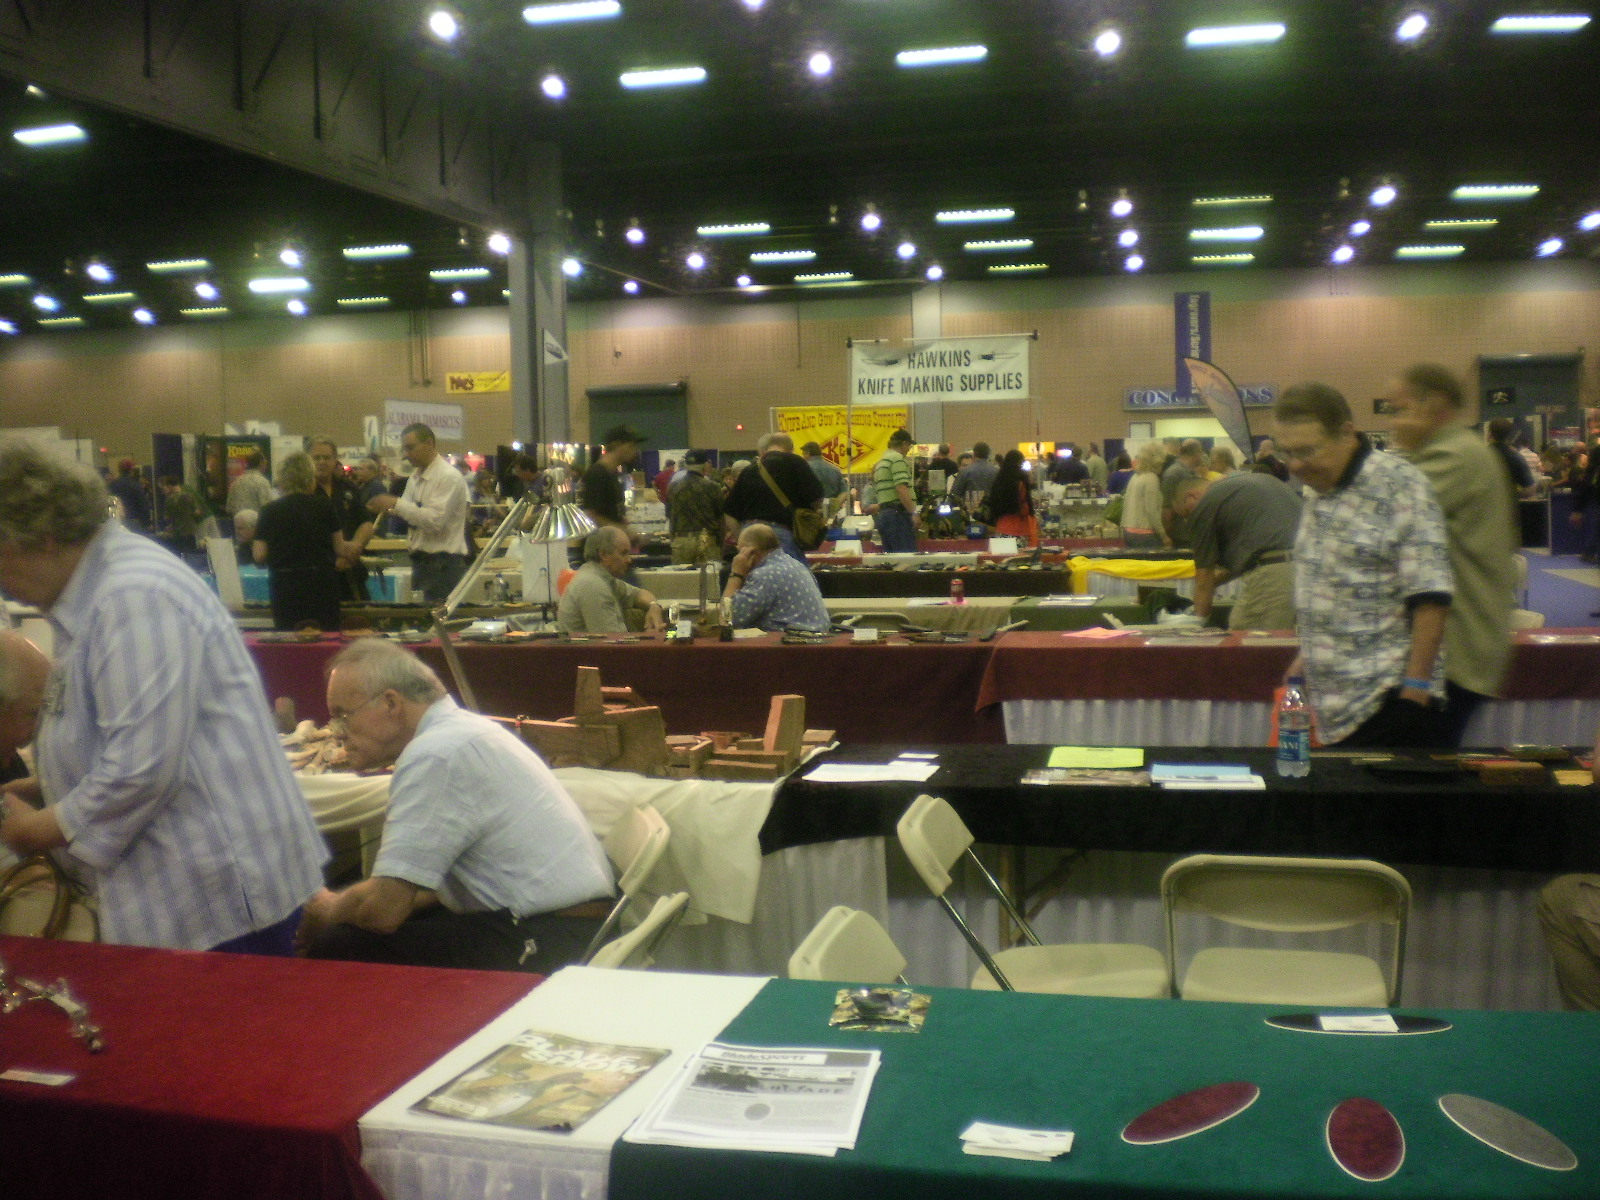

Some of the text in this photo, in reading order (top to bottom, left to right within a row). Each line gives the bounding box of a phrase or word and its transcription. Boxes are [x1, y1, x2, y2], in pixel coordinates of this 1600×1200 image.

[908, 350, 971, 369] HAWKINS
[858, 372, 1023, 395] KNIFE MAKING SUPPLIES
[423, 413, 460, 430] DAMASCUS
